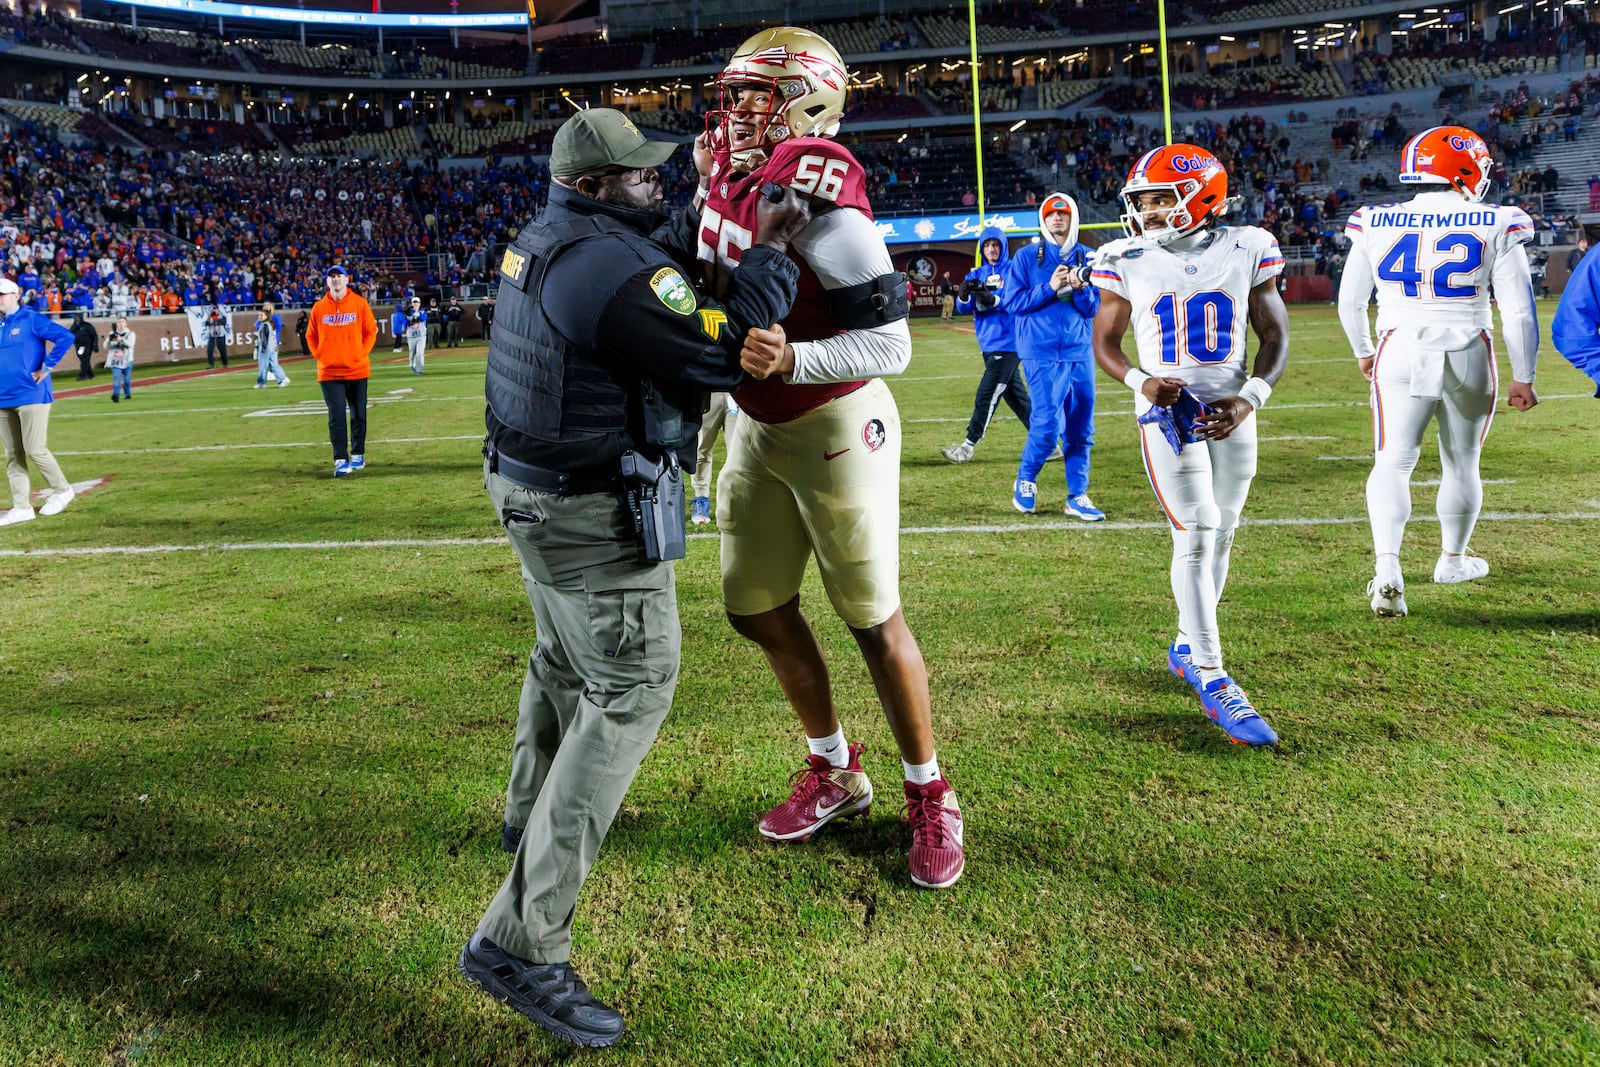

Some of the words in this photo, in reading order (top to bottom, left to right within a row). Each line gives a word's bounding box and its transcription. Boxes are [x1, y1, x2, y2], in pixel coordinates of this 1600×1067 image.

[790, 154, 849, 202] 56
[1371, 211, 1496, 228] UNDERWOOD
[1376, 230, 1487, 300] 42
[1151, 288, 1237, 366] 10
